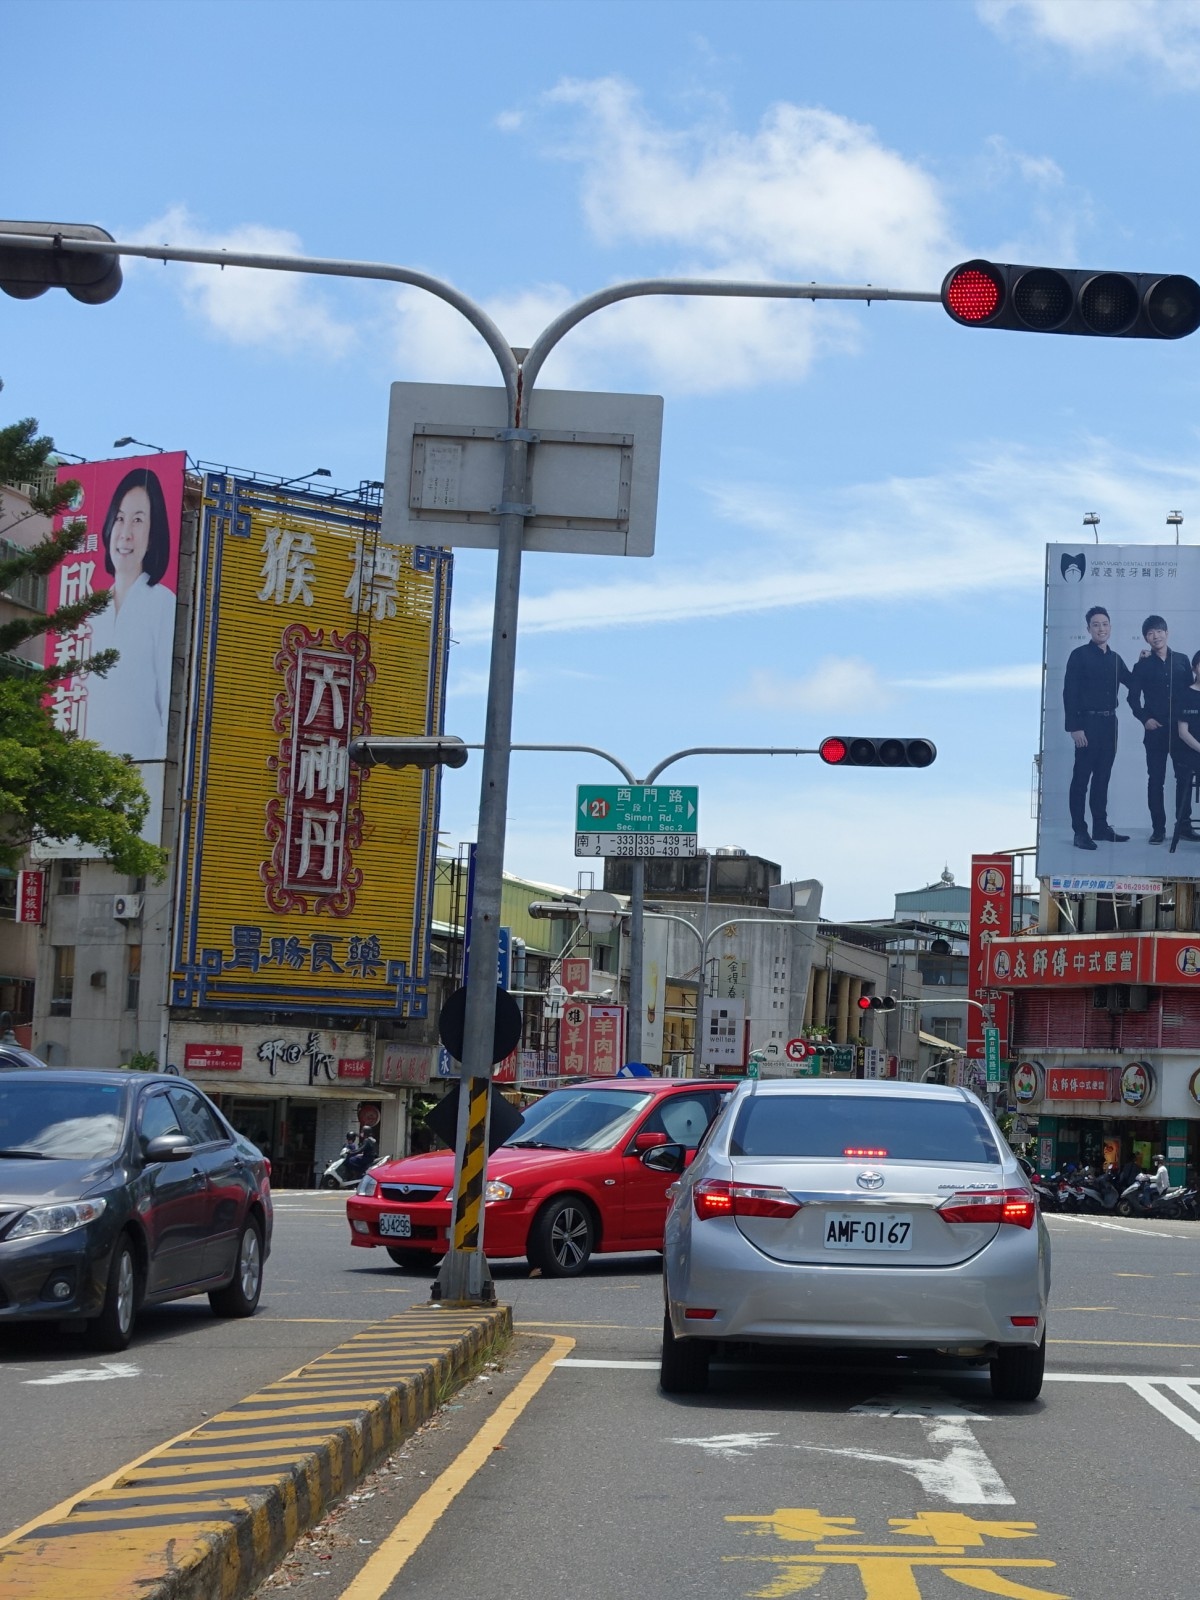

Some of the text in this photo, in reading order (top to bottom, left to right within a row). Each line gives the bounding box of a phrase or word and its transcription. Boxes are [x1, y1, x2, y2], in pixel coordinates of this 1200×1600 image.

[293, 661, 351, 882] 六神丹
[617, 788, 684, 803] 西門路
[591, 801, 607, 817] 21
[624, 813, 675, 822] Simen Rd.
[577, 835, 589, 848] 南
[682, 836, 695, 848] 北
[1073, 950, 1133, 972] 中式便當
[593, 1018, 614, 1073] 羊肉爐
